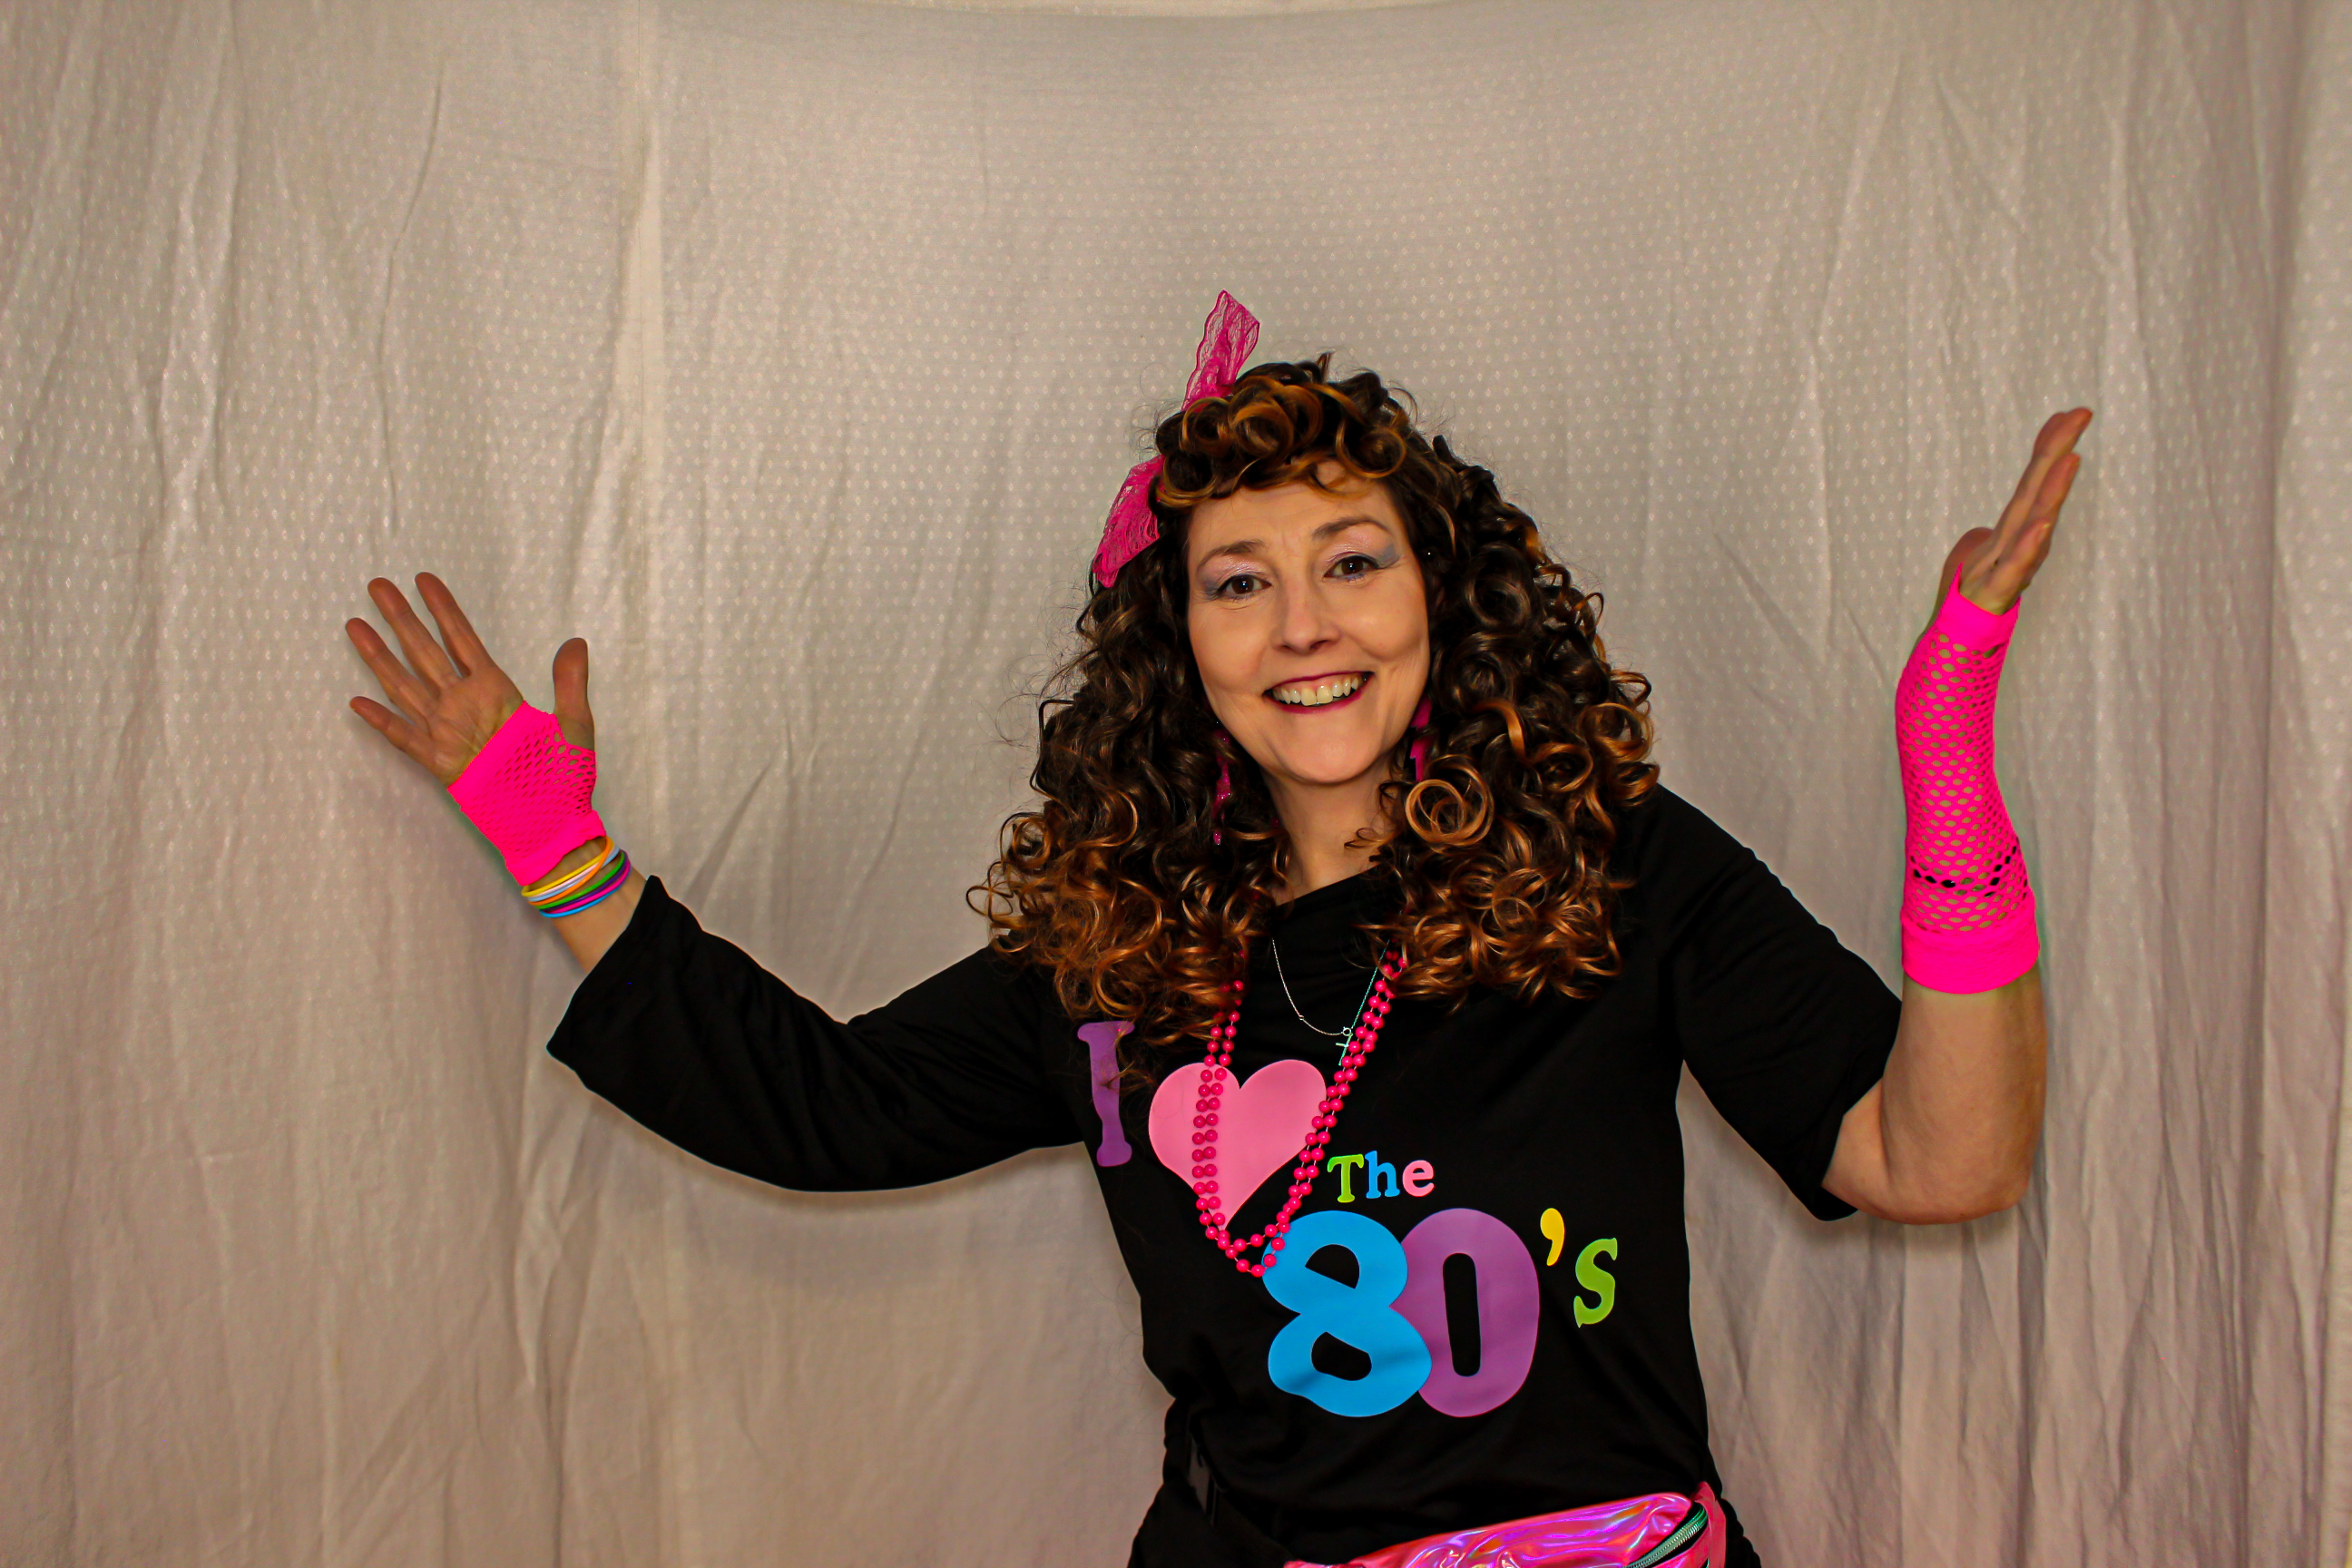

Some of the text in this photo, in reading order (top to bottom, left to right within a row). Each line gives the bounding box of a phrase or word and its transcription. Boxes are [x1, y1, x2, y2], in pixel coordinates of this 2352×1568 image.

[1077, 1020, 1134, 1167] I
[1327, 1150, 1436, 1203] The
[1260, 1207, 1618, 1418] 80's
